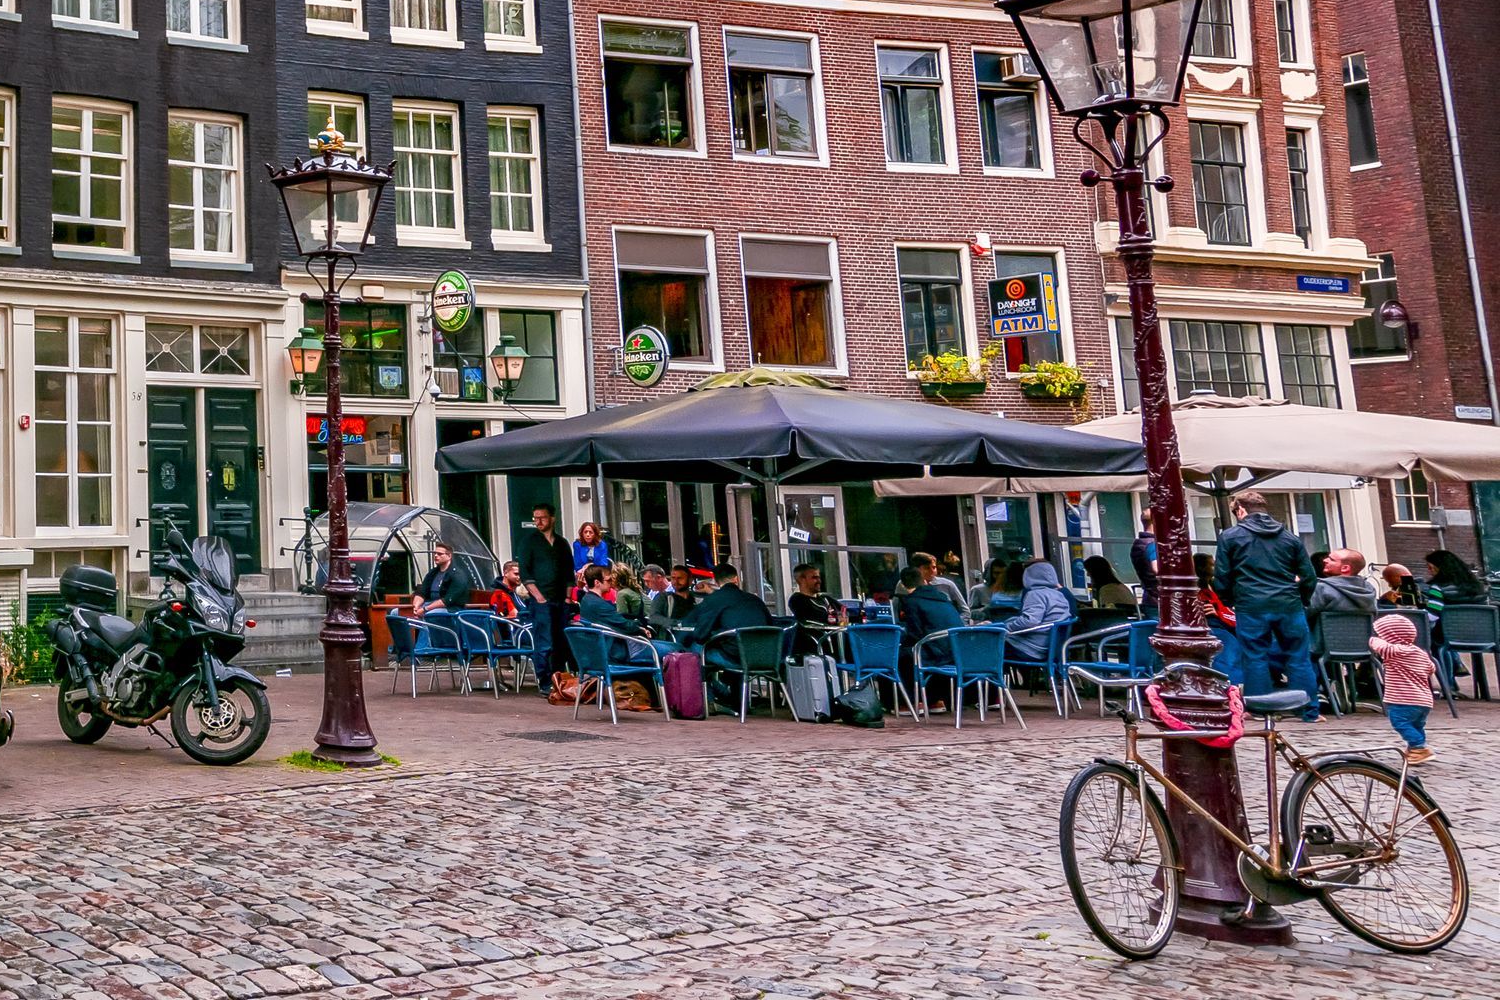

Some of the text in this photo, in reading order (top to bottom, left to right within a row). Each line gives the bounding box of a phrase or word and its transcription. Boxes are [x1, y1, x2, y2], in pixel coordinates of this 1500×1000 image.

[998, 306, 1037, 316] LUNCHROOM
[1000, 317, 1039, 332] ATM
[131, 391, 142, 401] 58
[794, 531, 805, 539] OPEN
